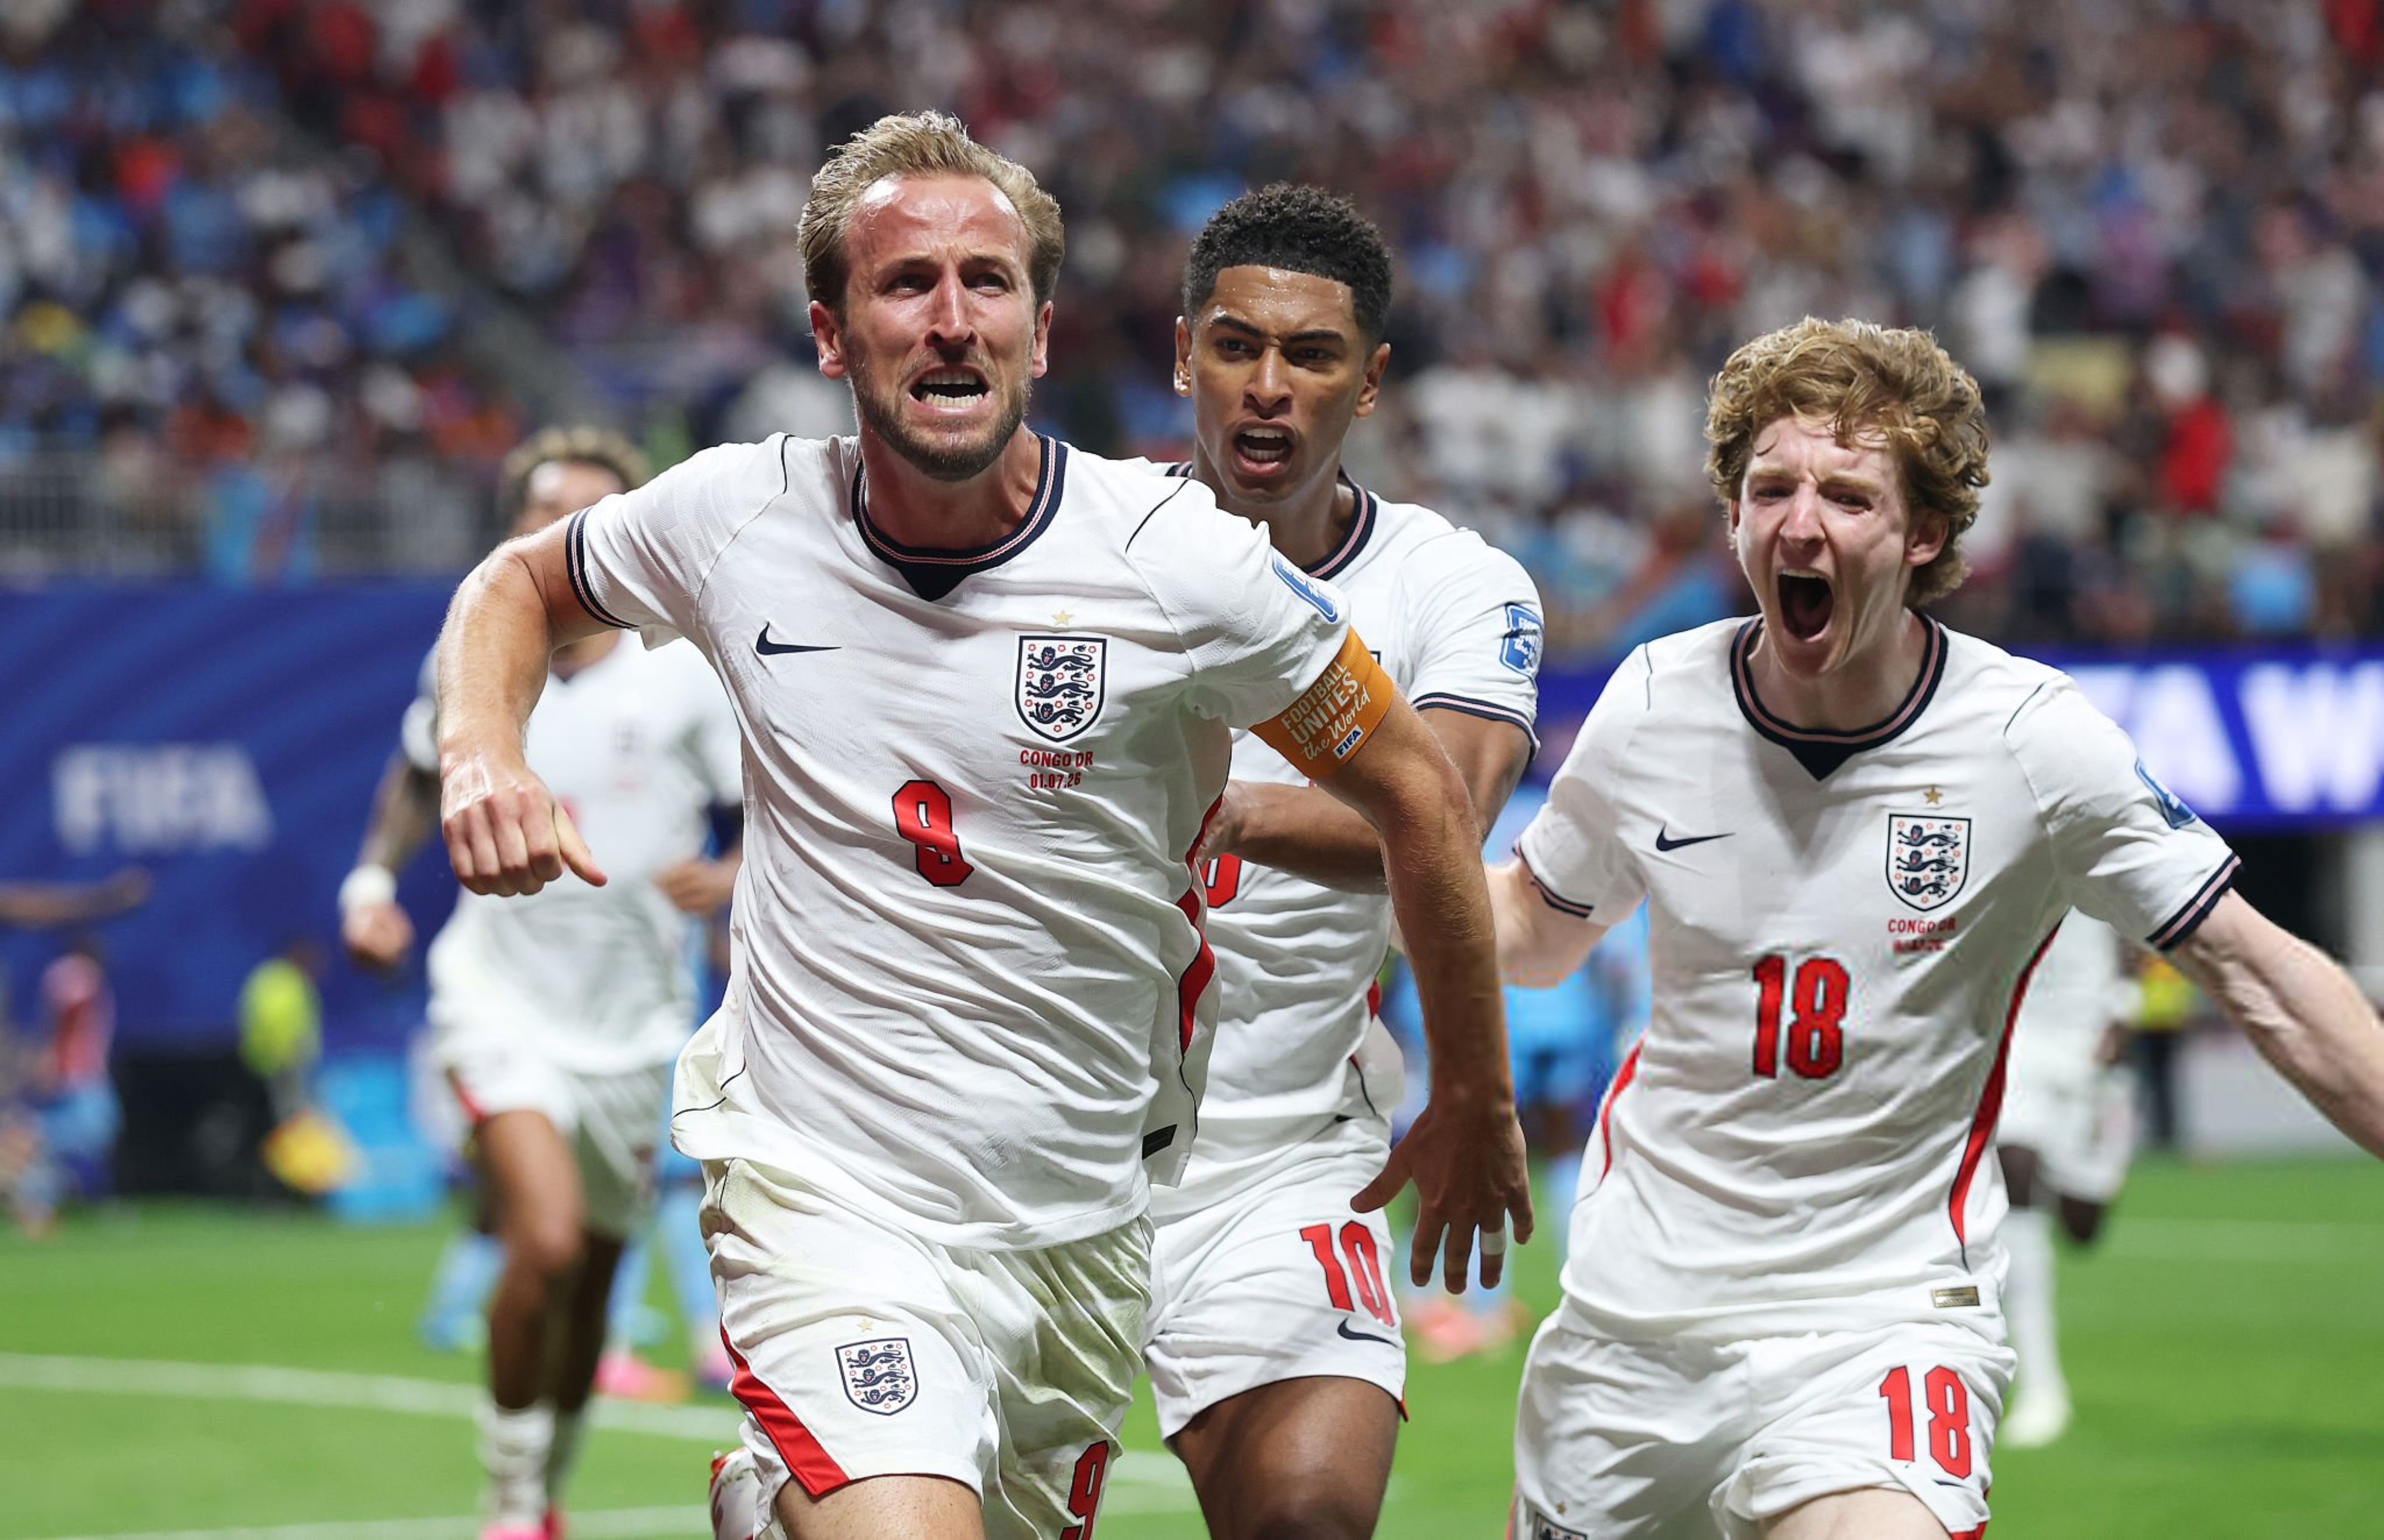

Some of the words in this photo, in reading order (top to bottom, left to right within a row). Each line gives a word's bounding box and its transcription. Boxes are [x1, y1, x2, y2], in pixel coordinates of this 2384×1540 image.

[1281, 661, 1347, 729] FOOTBALL
[1290, 672, 1358, 744] UNITES
[1300, 741, 1330, 760] the
[1327, 684, 1370, 739] World
[1020, 750, 1071, 767] CONGO
[1076, 751, 1094, 767] DR
[1031, 771, 1081, 789] 01.07.26
[1336, 730, 1361, 756] FIFA
[57, 744, 273, 852] FIFA
[1888, 919, 1936, 933] CONGO
[1752, 954, 1850, 1079] 18
[1299, 1220, 1395, 1327] 10
[1879, 1365, 1971, 1479] 18
[1059, 1440, 1109, 1540] 9
